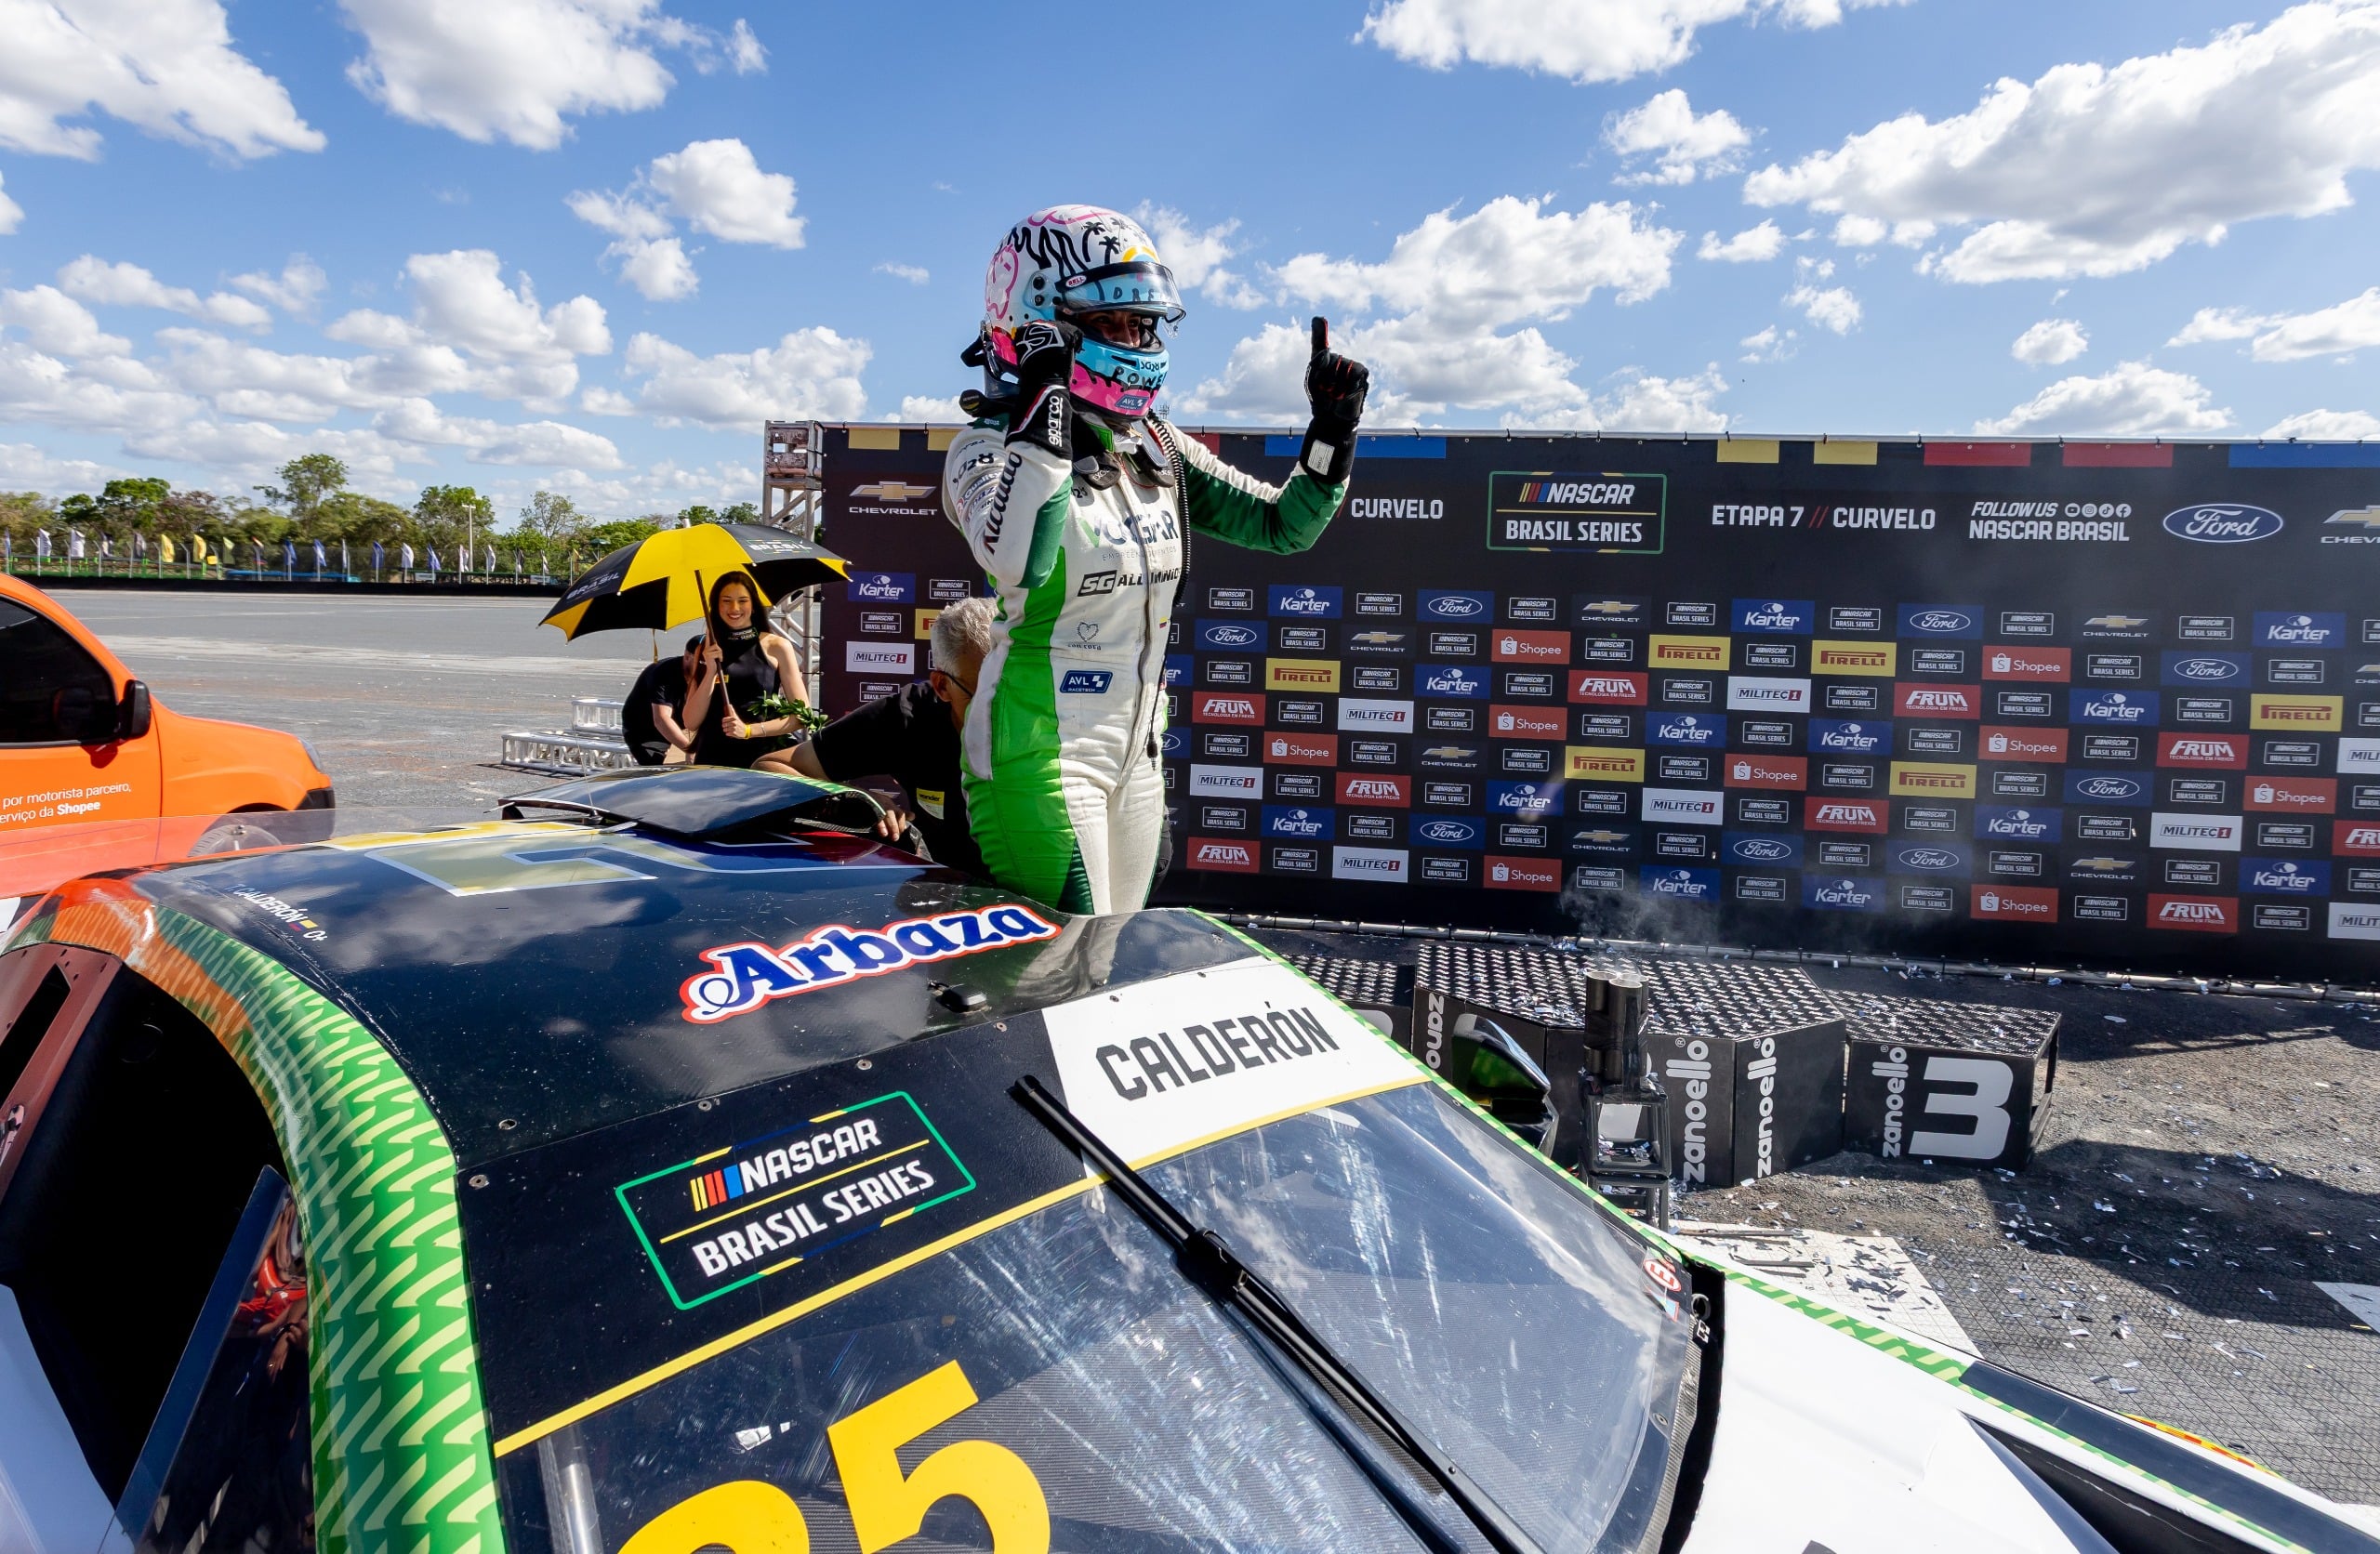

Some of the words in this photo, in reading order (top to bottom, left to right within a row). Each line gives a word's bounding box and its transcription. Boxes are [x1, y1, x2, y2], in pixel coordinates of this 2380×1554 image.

[1048, 395, 1064, 448] sparco
[1547, 483, 1635, 505] NASCAR
[849, 507, 938, 516] CHEVROLET
[1351, 498, 1444, 520] CURVELO
[1971, 501, 2036, 517] FOLLOW
[2034, 502, 2058, 517] US
[1712, 505, 1783, 527] ETAPA
[1790, 507, 1805, 527] 7
[1832, 507, 1936, 531] CURVELO
[2185, 508, 2259, 536] Ford
[1505, 520, 1573, 541] BRASIL
[1578, 521, 1642, 543] SERIES
[1969, 520, 2053, 540] NASCAR
[2056, 520, 2130, 542] BRASIL
[859, 583, 905, 597] Karter
[1280, 597, 1329, 611] Karter
[1438, 599, 1472, 613] Ford
[1744, 612, 1800, 626] Karter
[1922, 613, 1960, 628] Ford
[1215, 628, 1247, 642] Ford
[2268, 626, 2331, 641] Karter
[1520, 643, 1562, 656] Shopee
[1659, 644, 1721, 661] PIRELLI
[1822, 650, 1887, 667] PIRELLI
[2015, 660, 2061, 674] Shopee
[2185, 661, 2226, 677] Ford
[1068, 676, 1090, 686] AVL
[1275, 667, 1331, 683] PIRELLI
[1426, 678, 1477, 691] Karter
[1580, 678, 1636, 693] FRUM
[1907, 691, 1968, 706] FRUM
[1203, 699, 1255, 714] FRUM
[2083, 703, 2143, 718] Karter
[2260, 704, 2332, 721] PIRELLI
[1517, 718, 1558, 732] Shopee
[1659, 725, 1712, 740] Karter
[1822, 732, 1878, 747] Karter
[2011, 740, 2057, 754] Shopee
[1290, 745, 1329, 758] Shopee
[2169, 740, 2234, 757] FRUM
[1574, 756, 1635, 772] PIRELLI
[1753, 769, 1797, 782] Shopee
[1899, 771, 1965, 788] PIRELLI
[1346, 780, 1400, 795] FRUM
[2089, 779, 2129, 795] Ford
[3, 796, 23, 810] por
[27, 788, 83, 804] motorista
[86, 783, 132, 797] parceiro,
[1499, 794, 1550, 808] Karter
[2277, 791, 2326, 805] Shopee
[0, 807, 36, 823] erviço
[39, 806, 54, 818] da
[57, 801, 100, 816] Shopee
[1818, 805, 1878, 820] FRUM
[1273, 819, 1321, 833] Karter
[1430, 823, 1463, 838] Ford
[1989, 819, 2047, 834] Karter
[1198, 845, 1250, 860] FRUM
[1744, 841, 1780, 856] Ford
[1911, 850, 1949, 866] Ford
[1512, 870, 1553, 883] Shopee
[2254, 872, 2316, 887] Karter
[1652, 879, 1706, 893] Karter
[1815, 889, 1871, 903] Karter
[233, 888, 308, 923] CALDERÓN
[2002, 899, 2047, 913] Shopee
[2159, 902, 2224, 917] FRUM
[695, 904, 1051, 1018] Arbaza
[1425, 993, 1445, 1070] zano
[1095, 1001, 1341, 1101] CALDERÓN
[1747, 1037, 1777, 1178] zanoello
[1871, 1047, 1910, 1158] zanoello
[1908, 1056, 2014, 1160] 3
[1665, 1039, 1712, 1183] zanoello
[737, 1118, 882, 1193] NASCAR
[692, 1202, 829, 1278] BRASIL
[833, 1159, 935, 1223] SERIES
